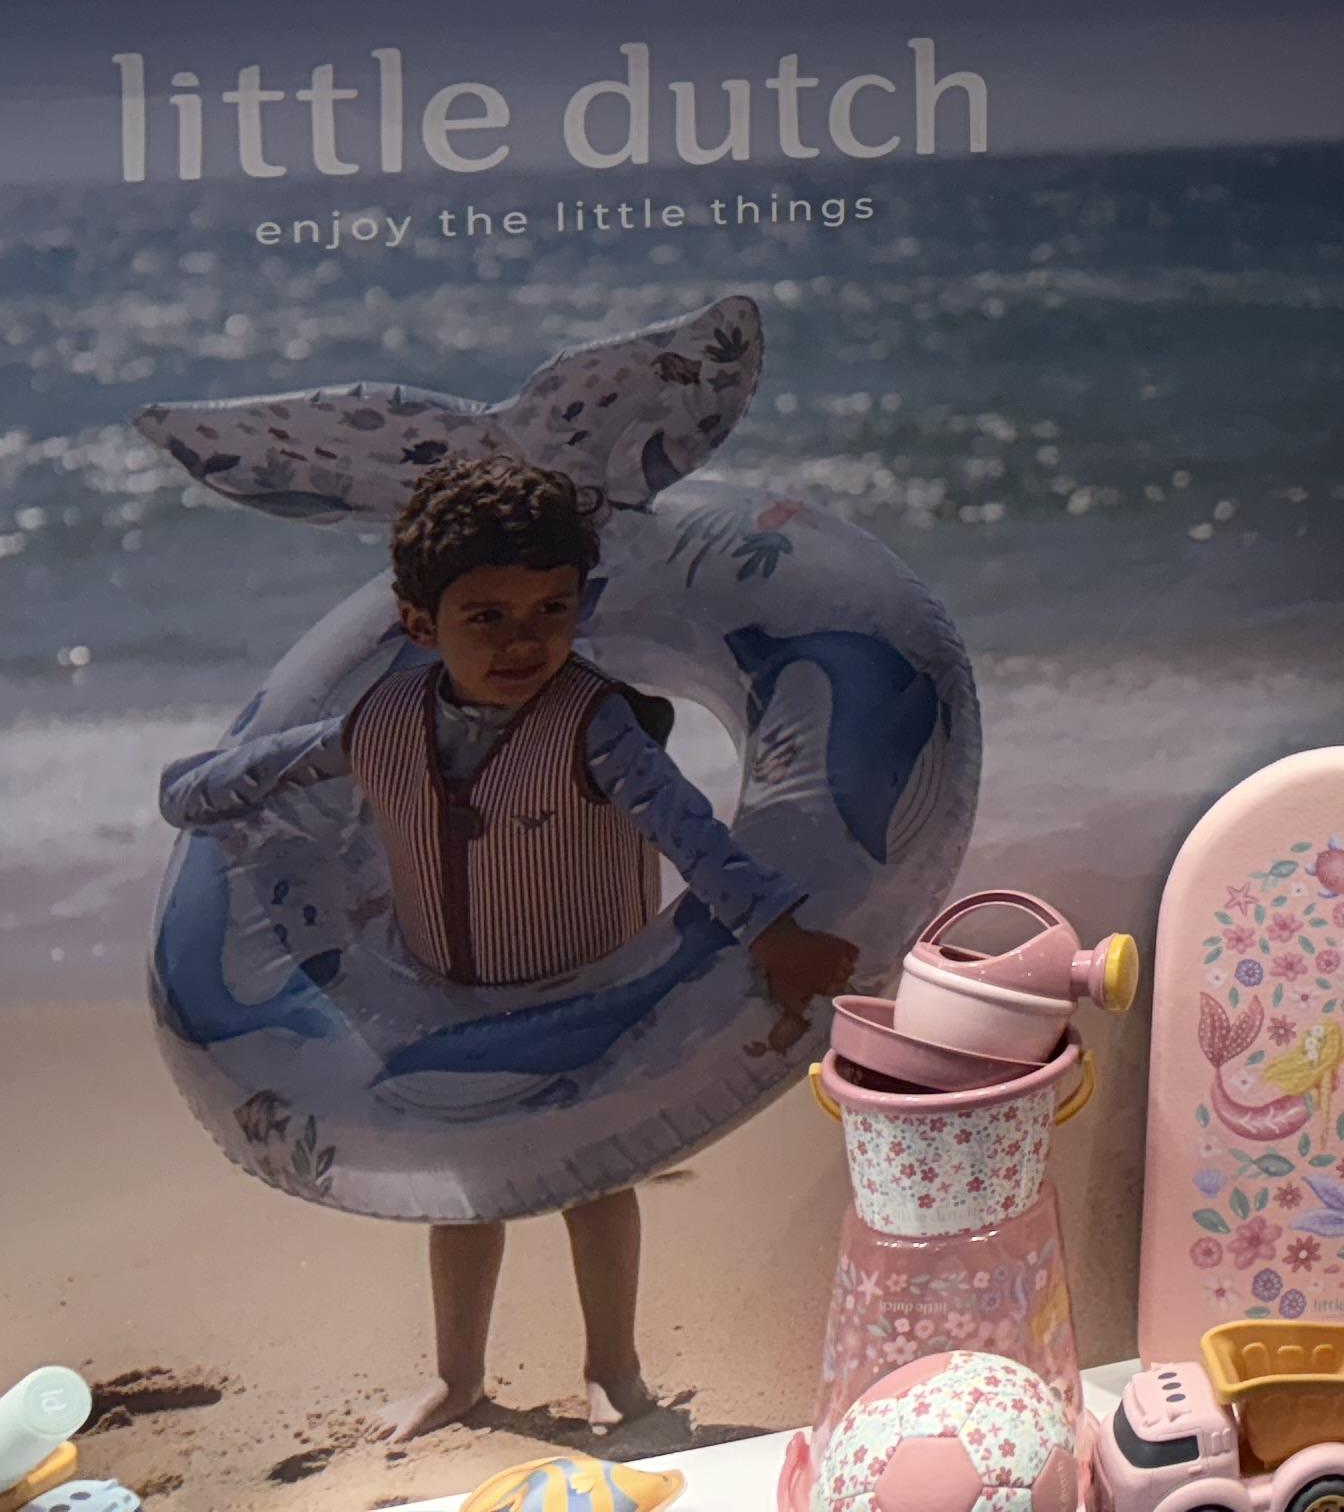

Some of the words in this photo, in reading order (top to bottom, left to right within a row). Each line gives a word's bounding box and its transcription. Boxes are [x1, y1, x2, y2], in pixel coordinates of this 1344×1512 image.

[111, 47, 512, 183] little
[562, 37, 992, 170] dutch
[254, 211, 413, 248] enjoy
[438, 201, 530, 237] the
[554, 194, 689, 233] little
[709, 190, 877, 228] things
[914, 1300, 949, 1314] little
